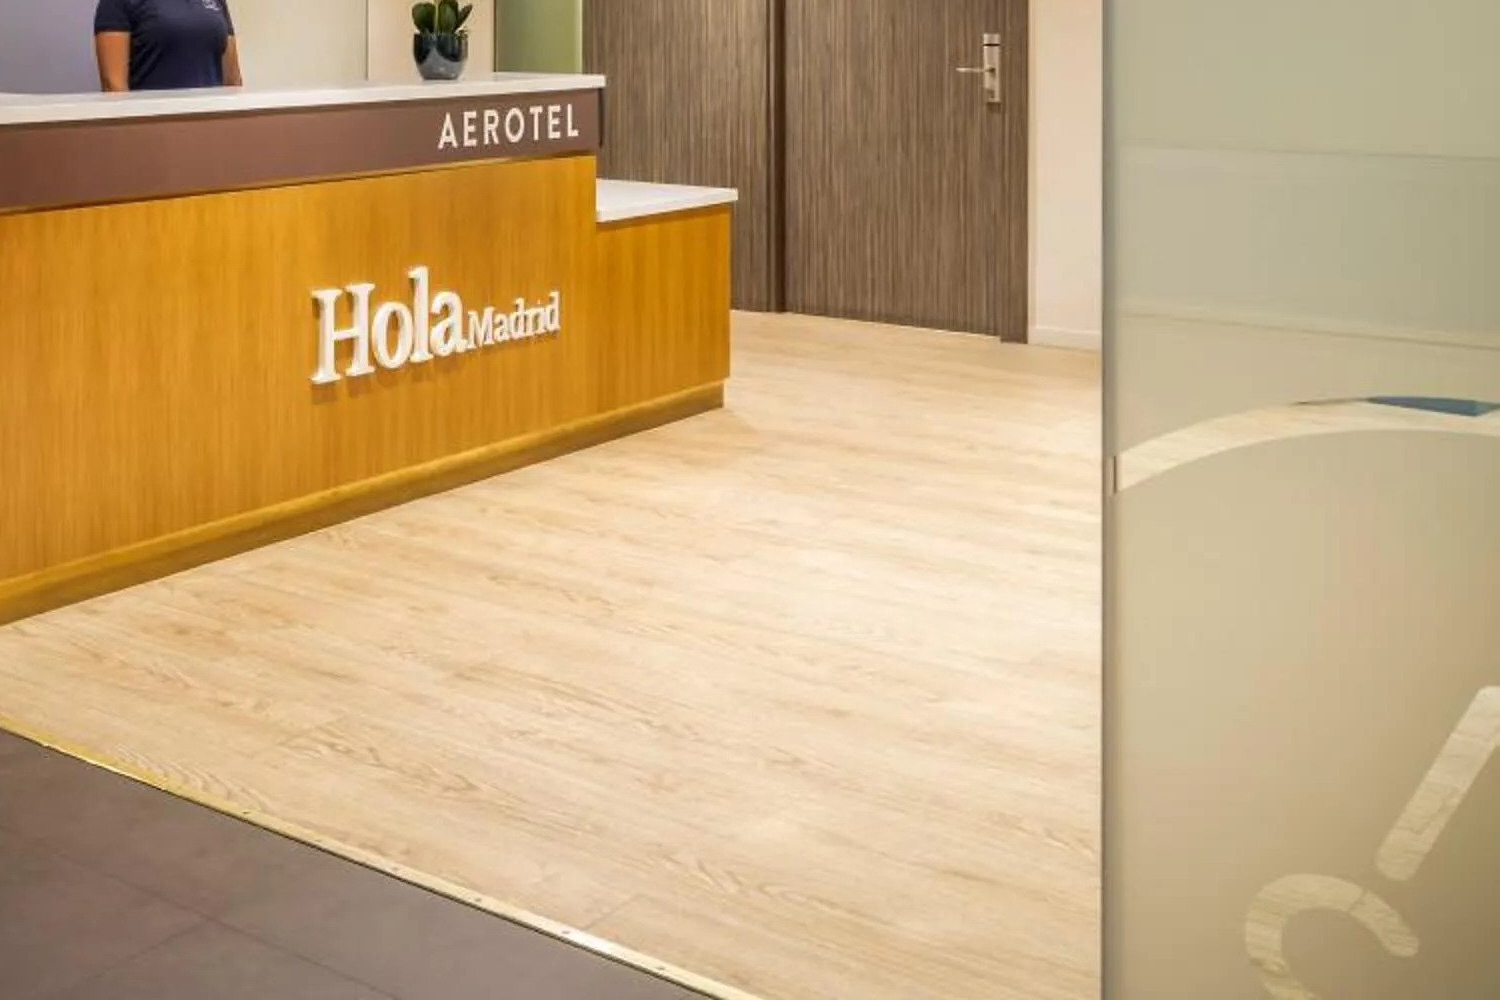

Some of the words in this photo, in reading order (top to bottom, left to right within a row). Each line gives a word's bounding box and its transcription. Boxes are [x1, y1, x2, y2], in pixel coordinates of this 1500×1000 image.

[437, 103, 579, 149] AEROTEL
[309, 265, 467, 384] Hola
[467, 291, 560, 349] Madrid
